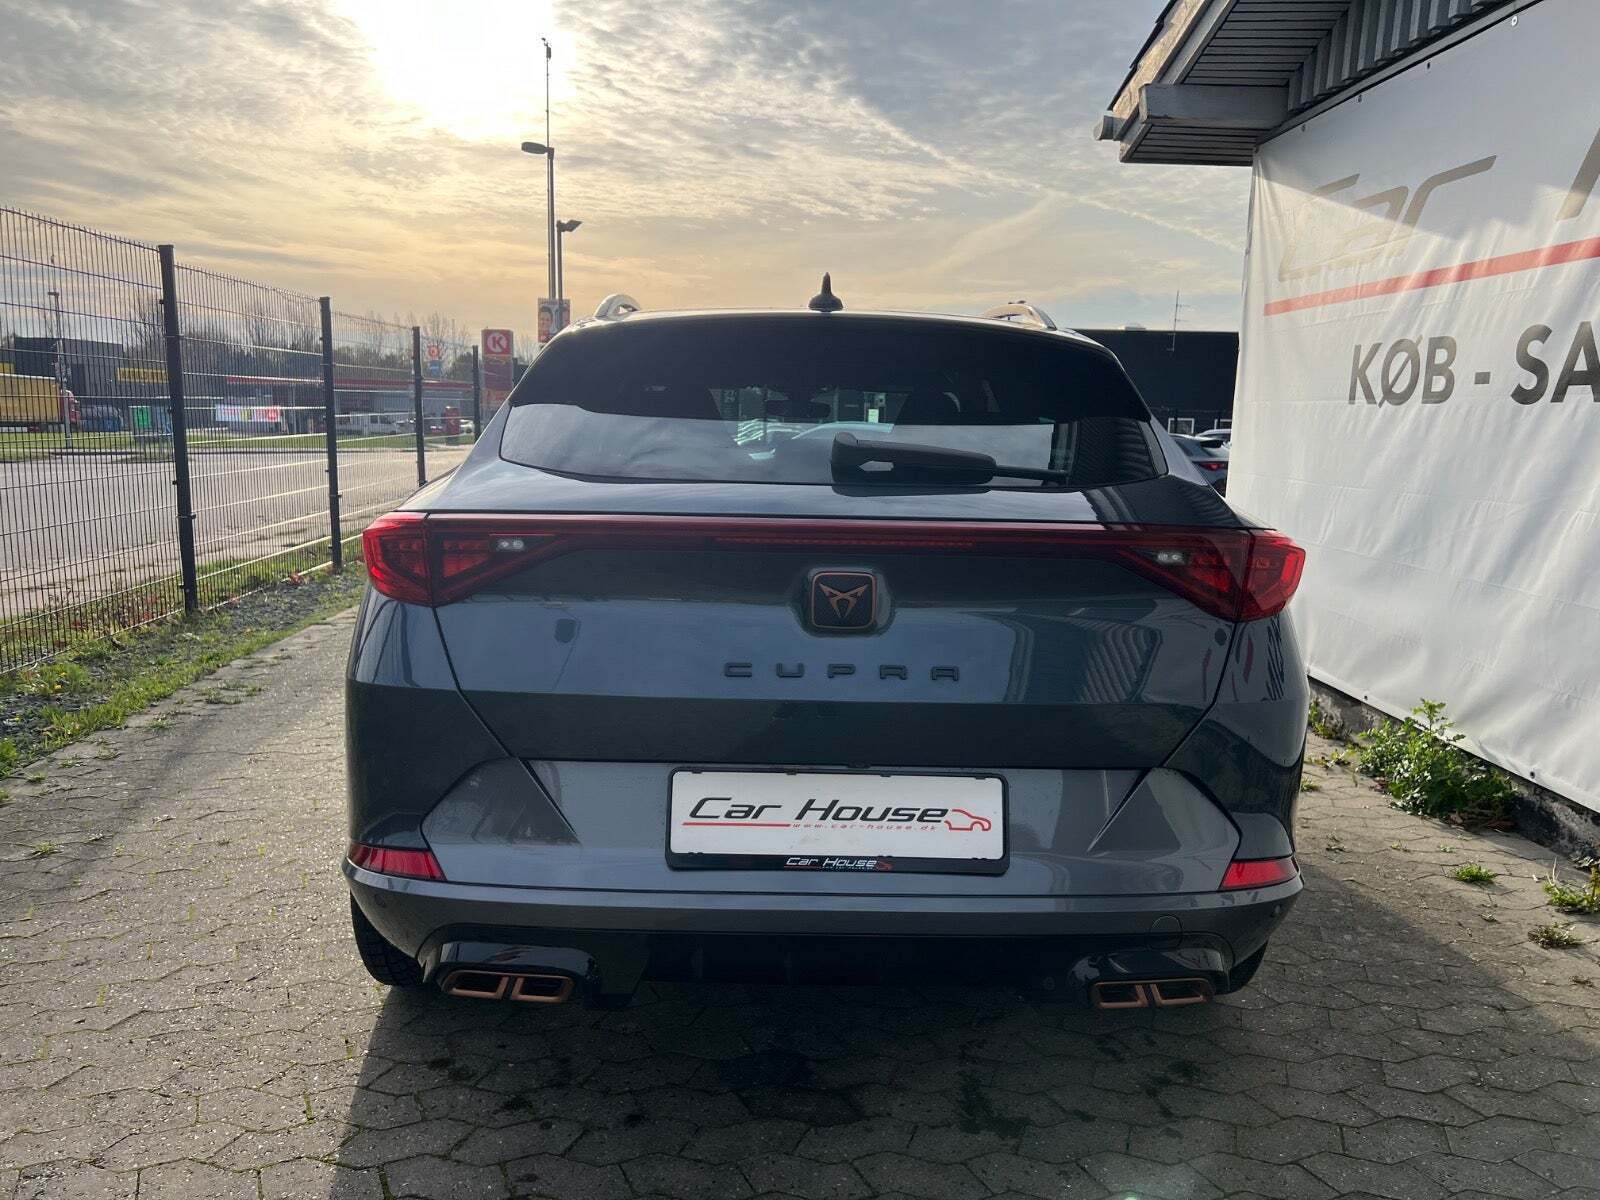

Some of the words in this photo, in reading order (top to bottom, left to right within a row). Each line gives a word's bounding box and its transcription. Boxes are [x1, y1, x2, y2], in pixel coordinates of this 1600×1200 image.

[1348, 334, 1457, 408] KØB
[724, 662, 960, 682] CUPRA
[689, 797, 783, 821] Car
[795, 798, 949, 824] House
[793, 822, 937, 832] www.car-house.dk
[786, 857, 818, 866] Car
[822, 858, 877, 867] House
